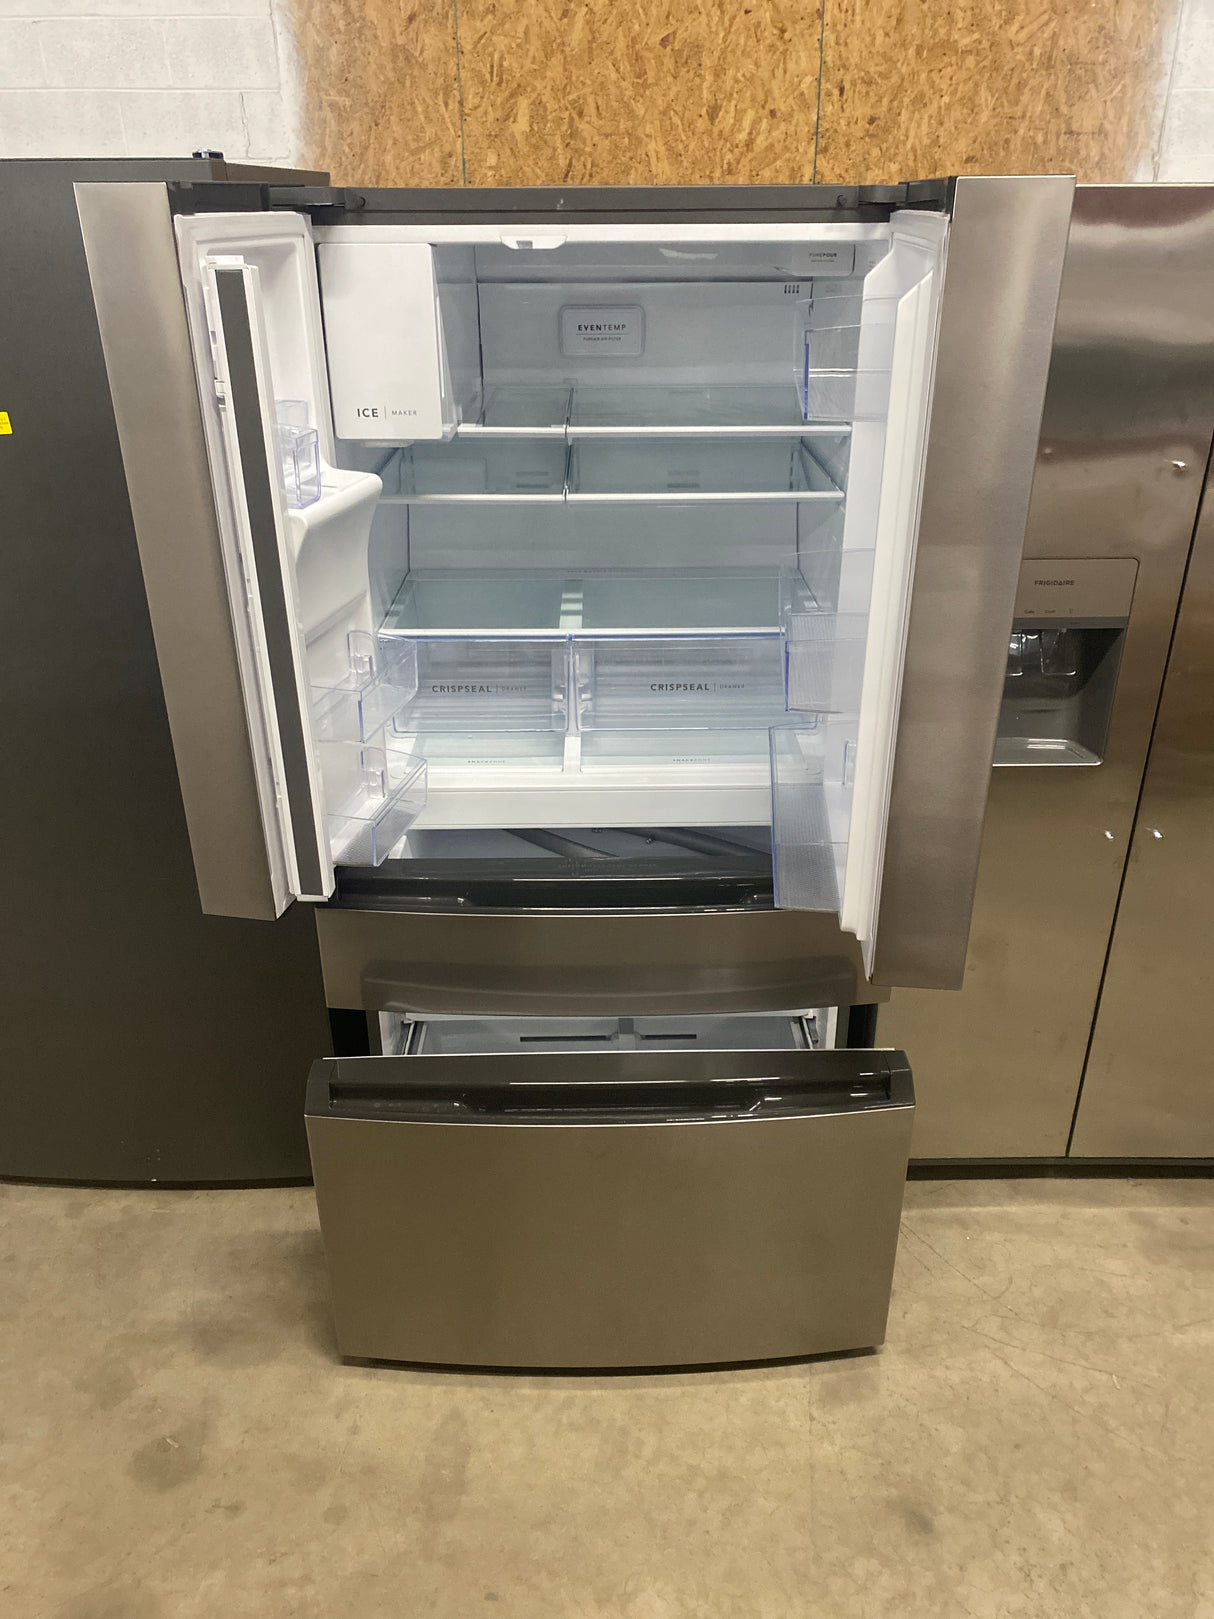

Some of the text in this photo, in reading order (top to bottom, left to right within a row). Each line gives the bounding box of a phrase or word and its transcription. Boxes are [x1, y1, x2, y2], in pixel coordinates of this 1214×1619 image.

[577, 324, 627, 332] EVENTEMP
[357, 408, 379, 418] ICE
[431, 684, 492, 693] CRISPSEAL
[650, 683, 710, 691] CRISPSEAL
